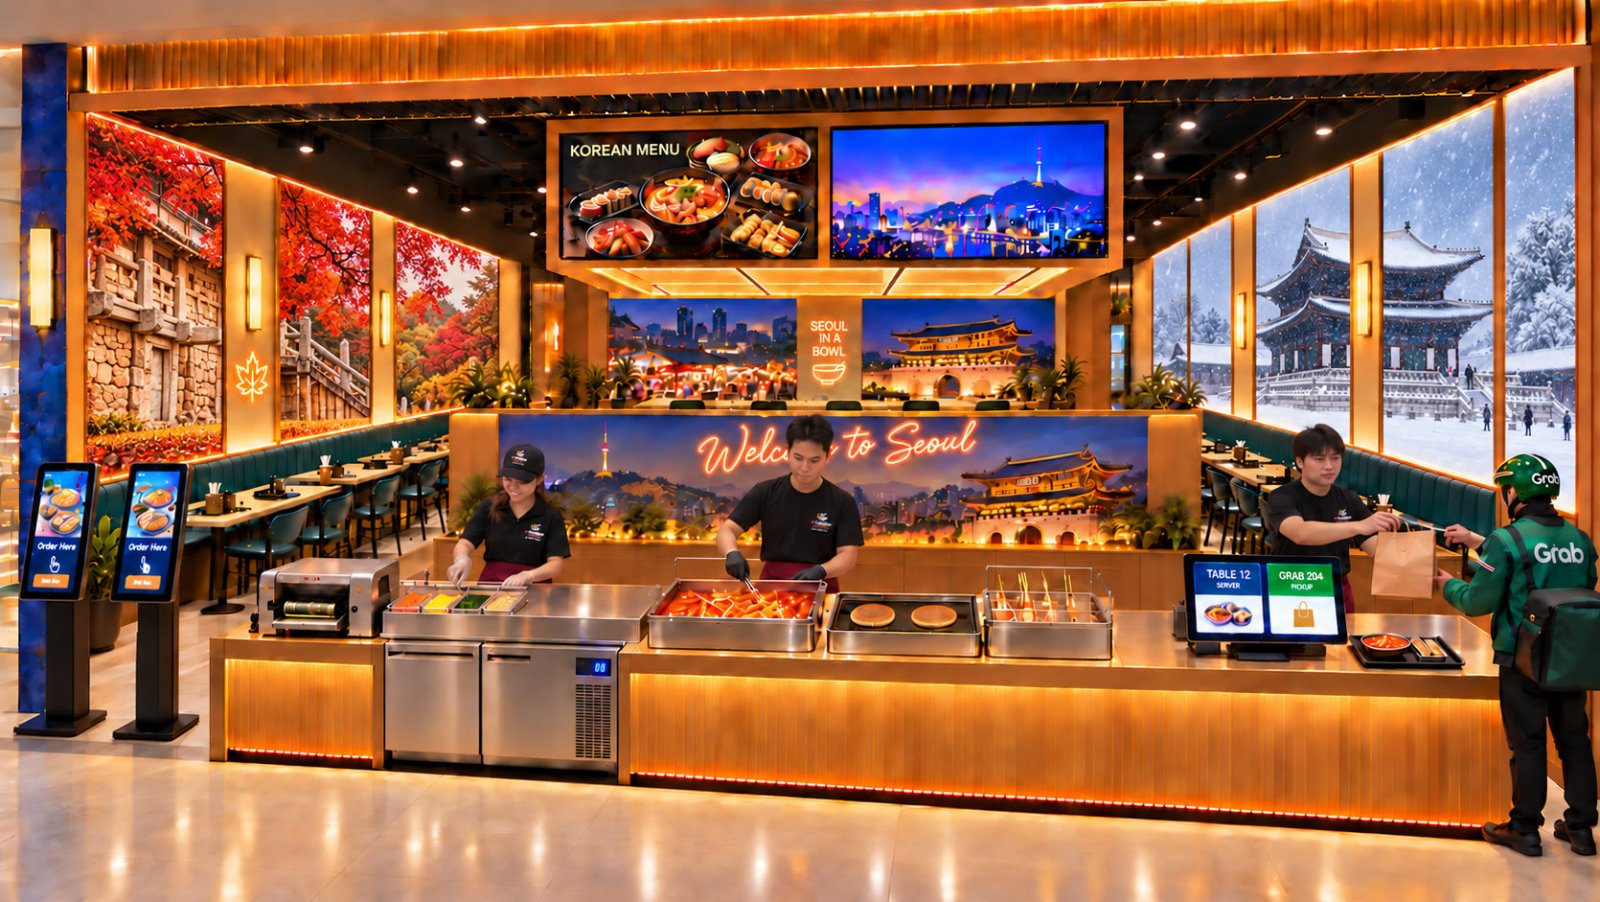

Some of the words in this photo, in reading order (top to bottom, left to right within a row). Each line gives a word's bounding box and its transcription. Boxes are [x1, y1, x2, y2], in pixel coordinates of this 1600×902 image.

[570, 144, 632, 157] KOREAN
[636, 143, 680, 156] MENU
[810, 320, 849, 332] SEOUL
[819, 333, 831, 343] IN
[833, 333, 841, 343] A
[812, 346, 847, 357] BOWL
[697, 423, 839, 474] Welc
[842, 425, 876, 459] to
[884, 420, 976, 465] Seoul
[1531, 472, 1560, 485] Grab
[37, 541, 58, 551] Order
[58, 542, 77, 551] Here
[128, 542, 150, 551] Order
[150, 543, 168, 552] Here
[1534, 542, 1585, 564] Grab
[1206, 568, 1237, 580] TABLE
[1239, 569, 1251, 580] 12
[1278, 571, 1305, 581] GRAB
[1306, 571, 1324, 581] 204
[1216, 581, 1241, 590] SERVER
